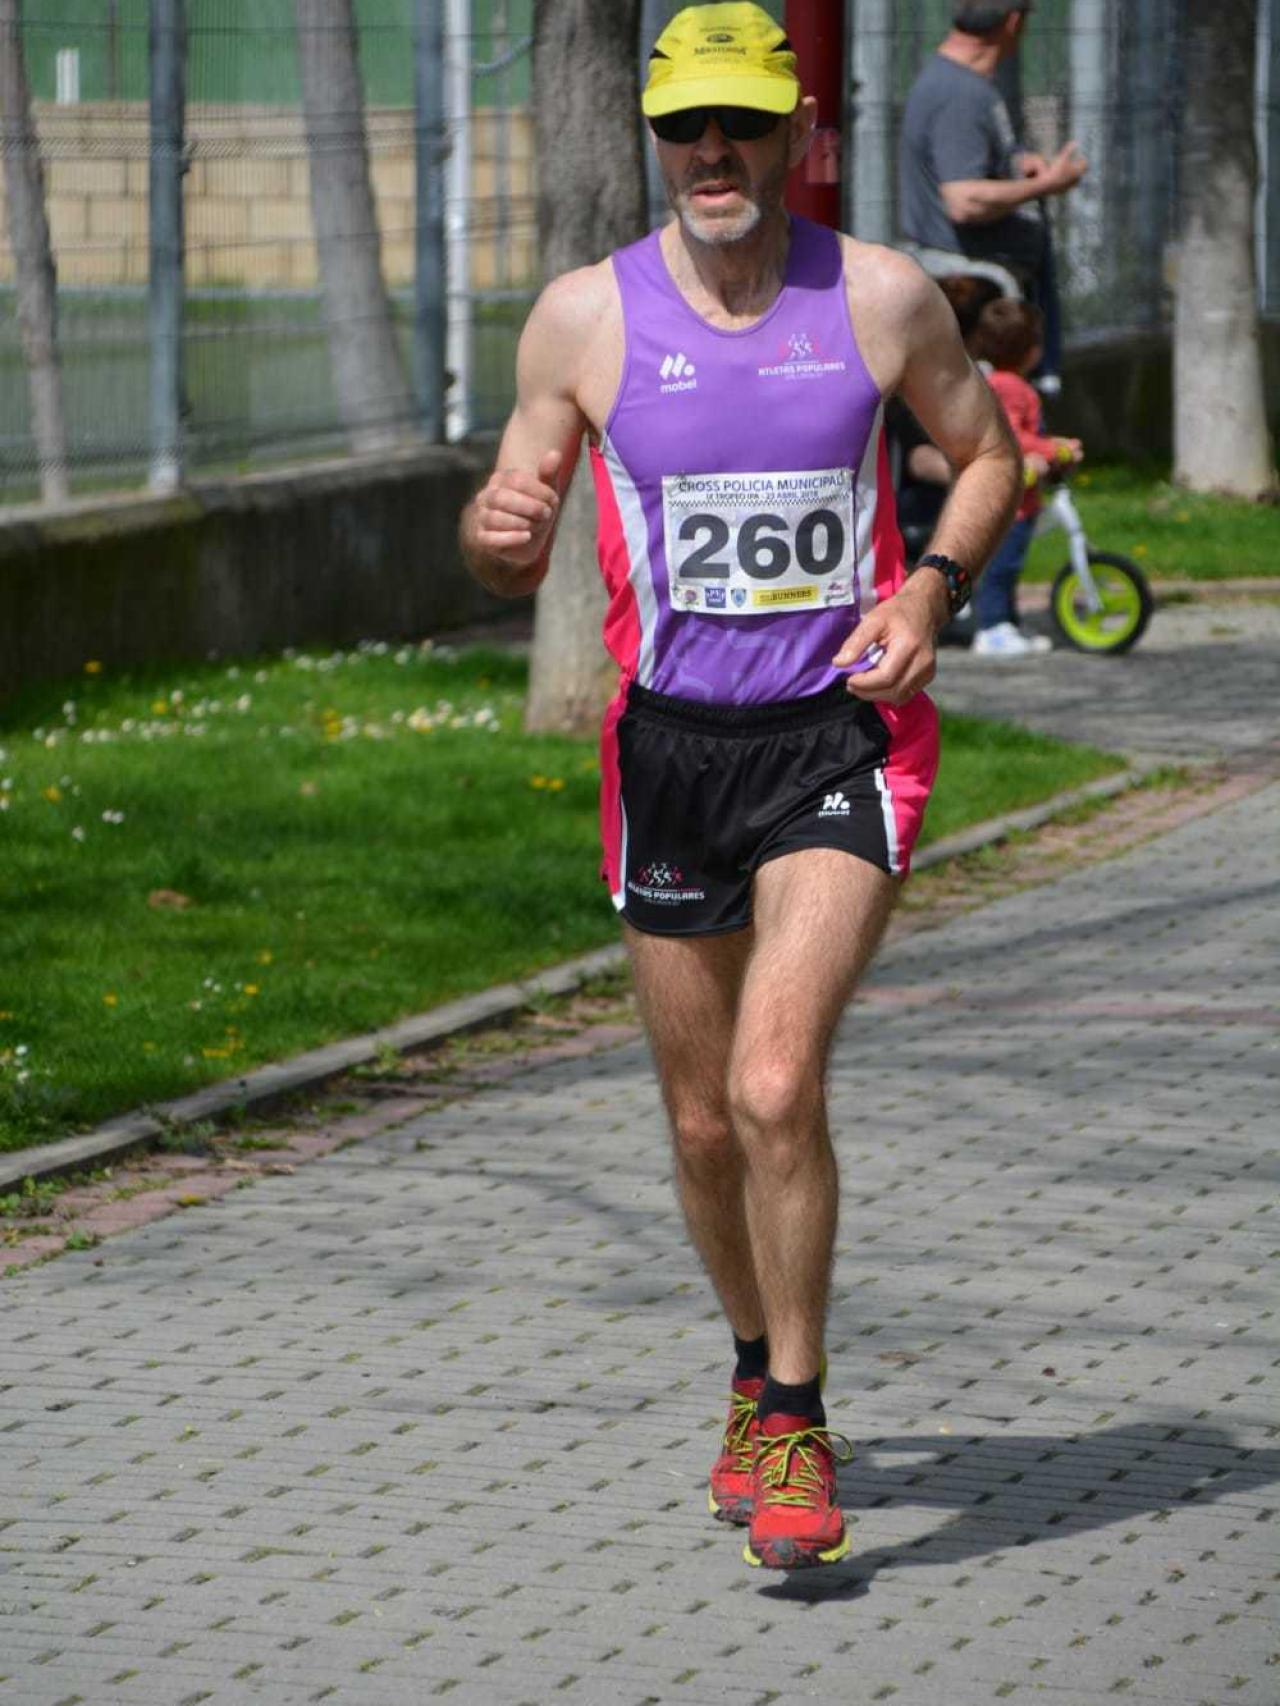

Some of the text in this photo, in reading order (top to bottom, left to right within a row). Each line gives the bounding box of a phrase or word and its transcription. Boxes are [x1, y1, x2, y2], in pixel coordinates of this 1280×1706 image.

[678, 476, 844, 492] CROSS POLICIA MUNICIPAL
[678, 508, 845, 580] 260
